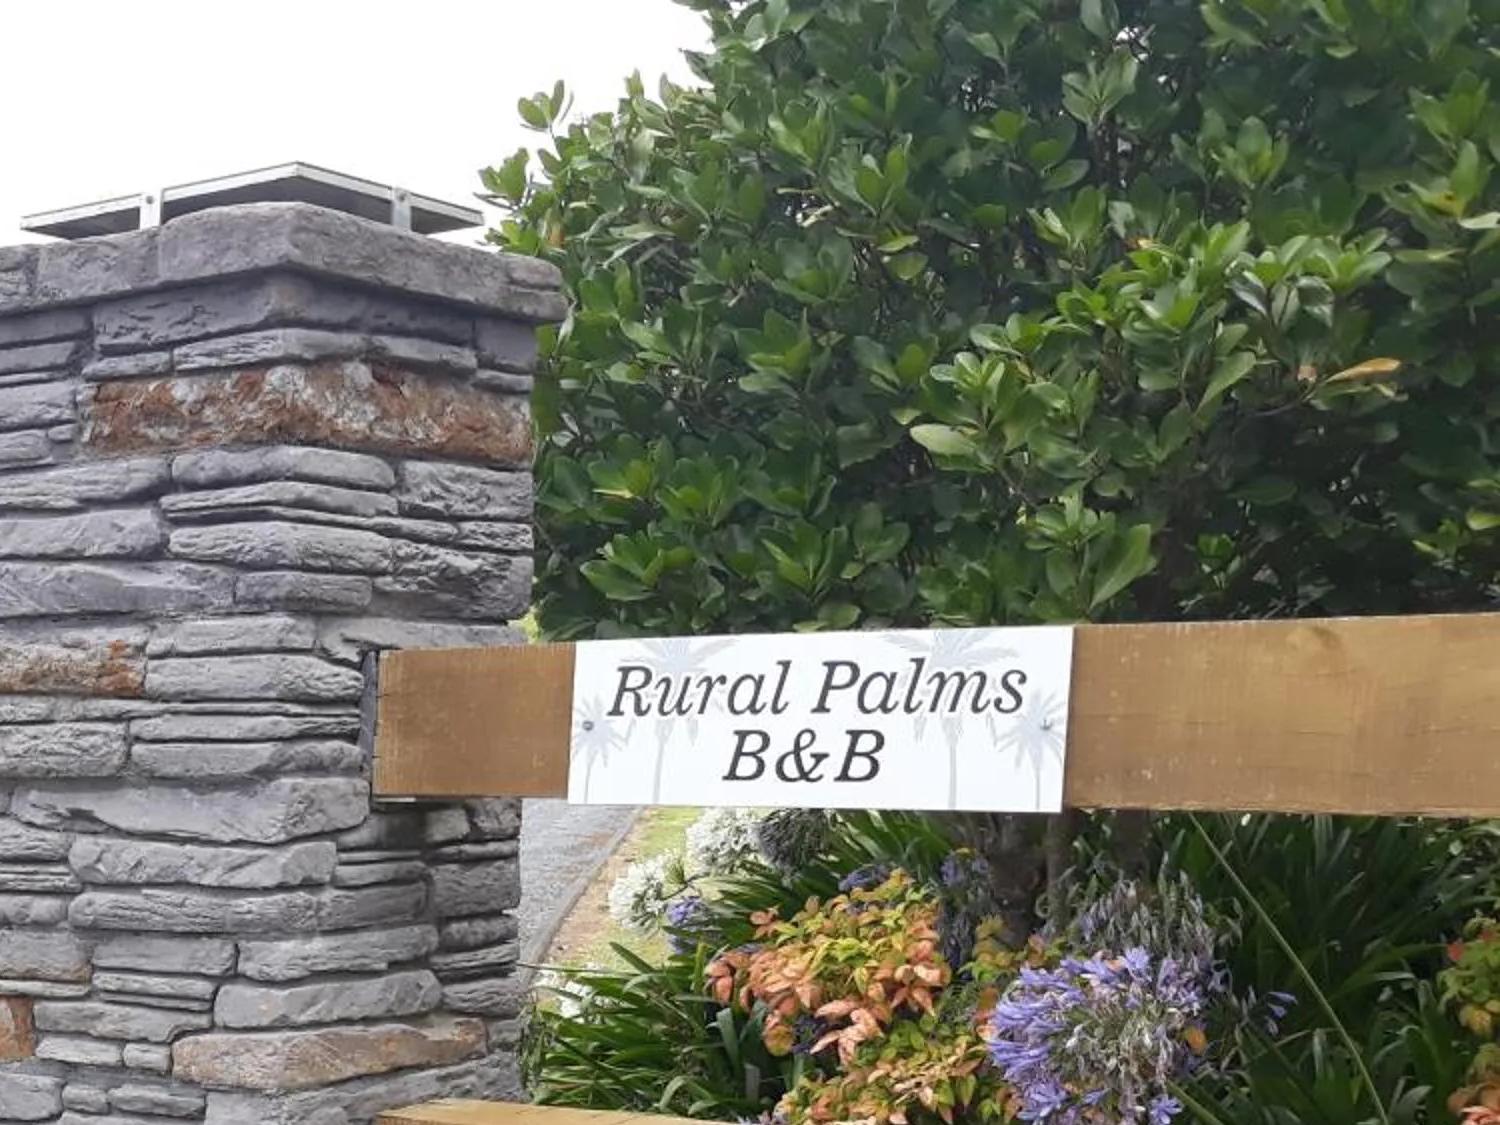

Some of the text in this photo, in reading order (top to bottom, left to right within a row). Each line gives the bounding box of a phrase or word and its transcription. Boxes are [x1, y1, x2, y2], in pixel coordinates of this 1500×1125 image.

[606, 657, 1028, 717] Rural Palms
[721, 728, 886, 783] B&B
